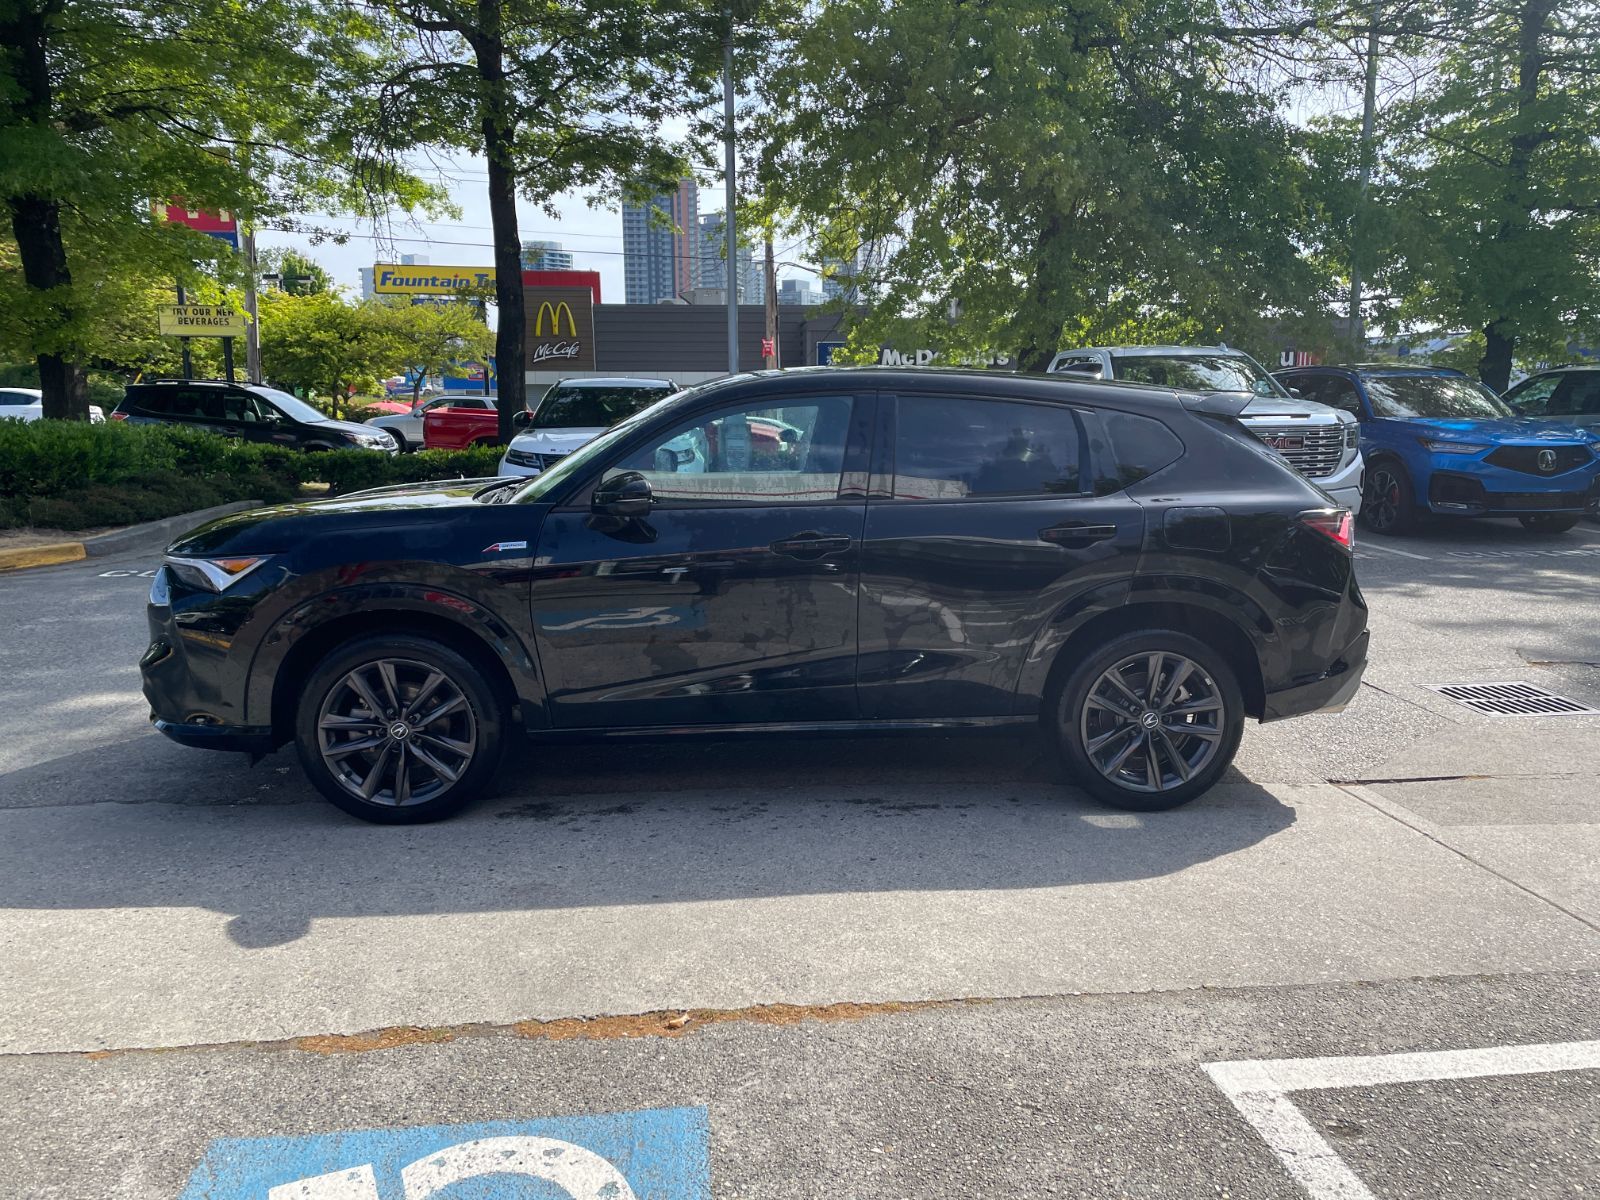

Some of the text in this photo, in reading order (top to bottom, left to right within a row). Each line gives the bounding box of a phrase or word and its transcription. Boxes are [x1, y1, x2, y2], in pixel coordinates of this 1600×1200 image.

[379, 270, 470, 288] Fountain
[172, 308, 188, 316] TRY
[192, 308, 211, 316] OUR
[178, 317, 230, 326] BEVERAGES
[1263, 437, 1302, 449] MC
